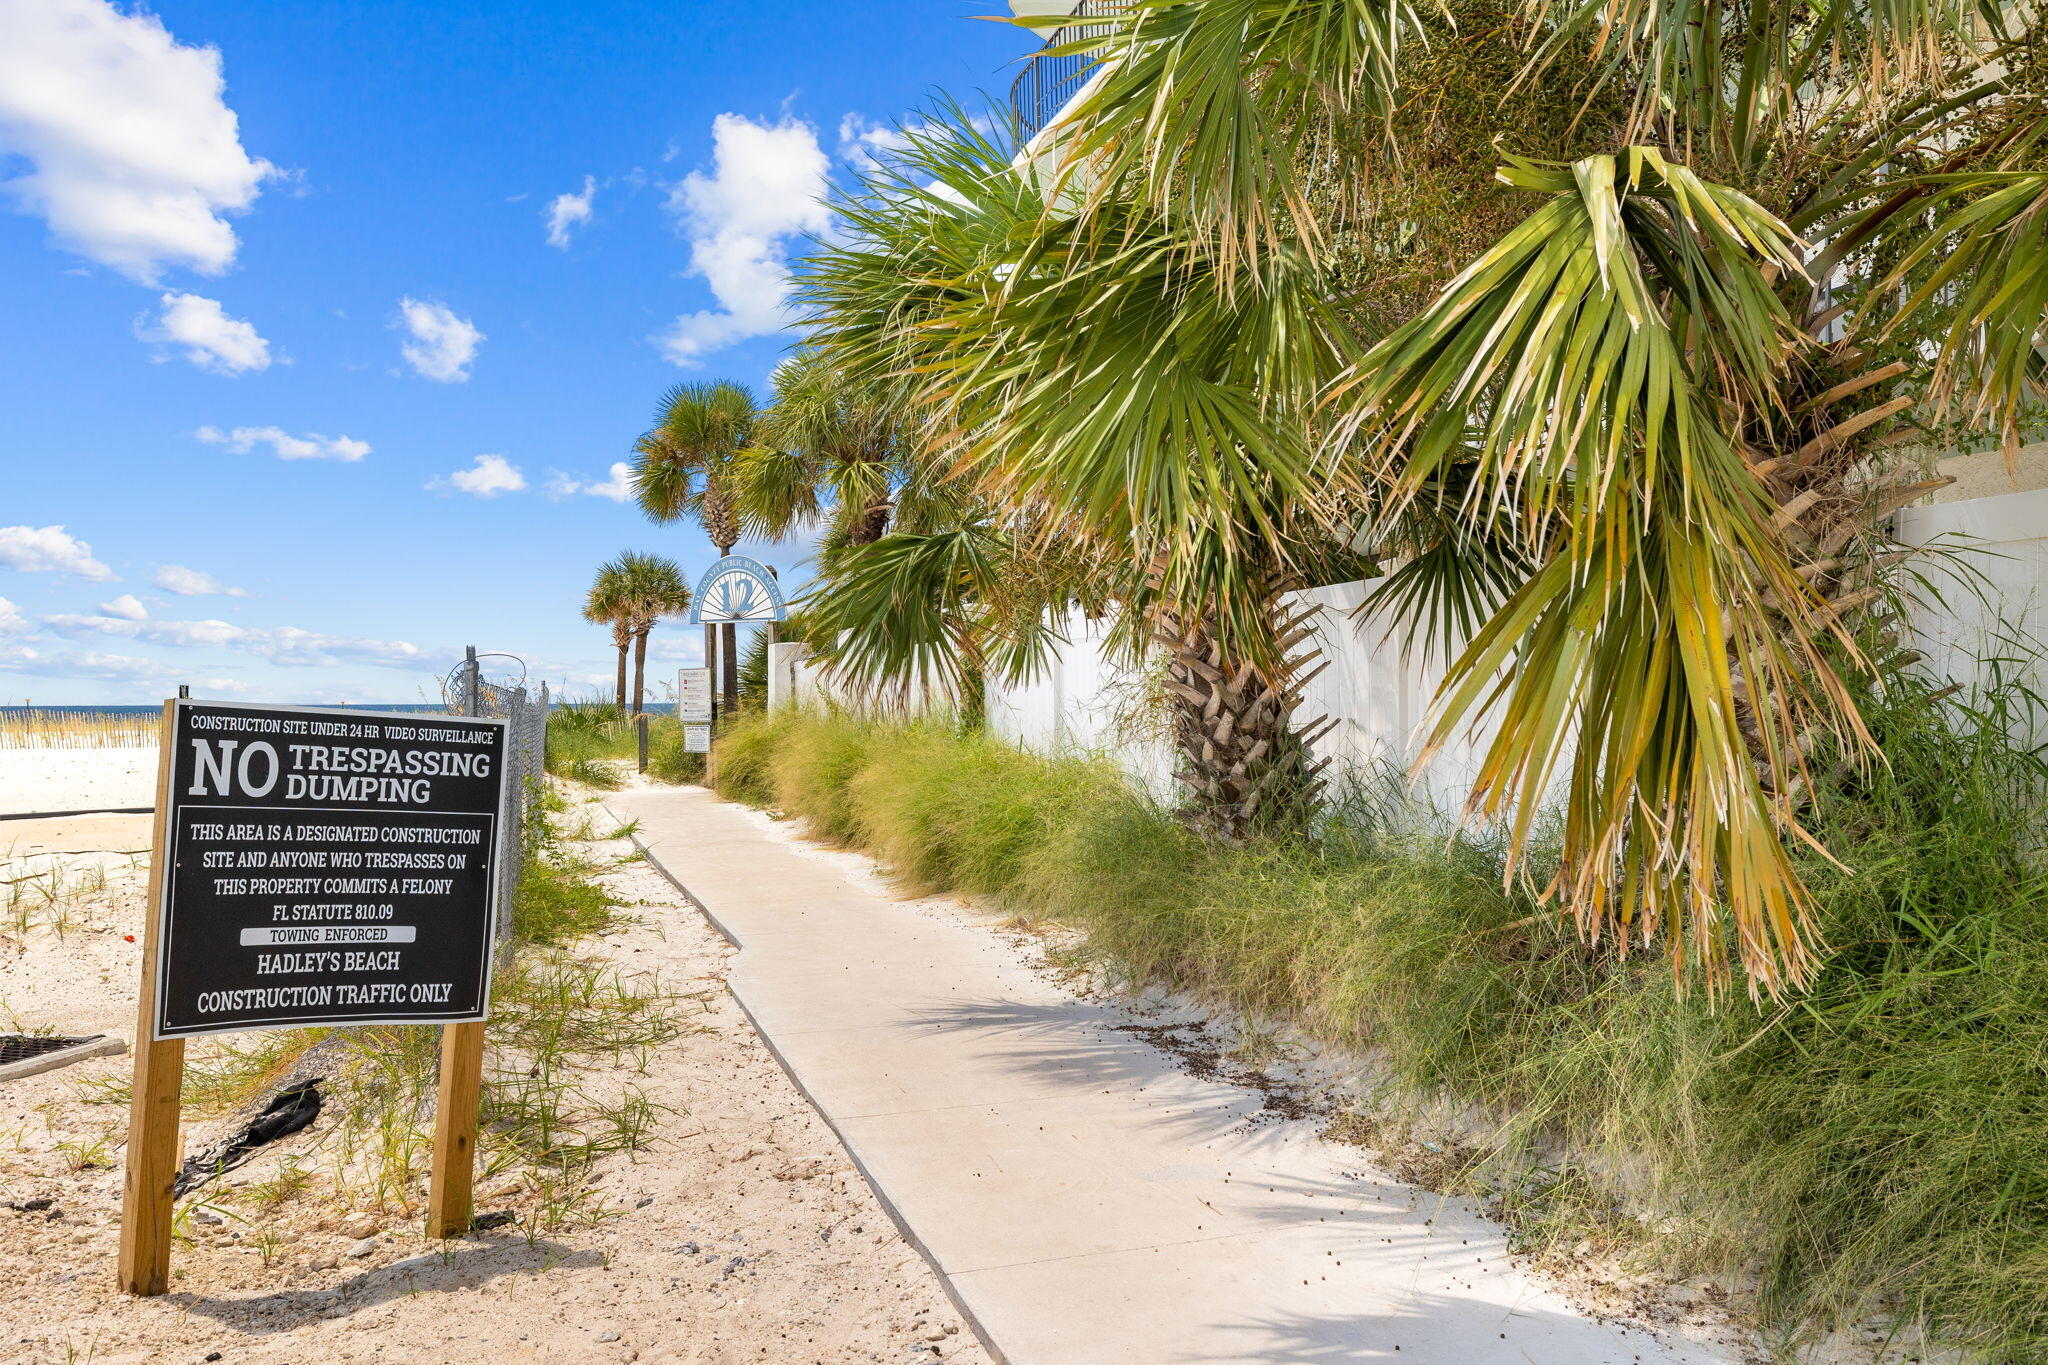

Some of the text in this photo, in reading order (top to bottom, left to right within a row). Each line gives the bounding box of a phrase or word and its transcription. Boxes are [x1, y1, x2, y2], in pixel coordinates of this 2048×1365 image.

[700, 565, 720, 591] COUNTY
[721, 559, 742, 568] PUBLIC
[744, 560, 765, 577] BEACH
[766, 577, 782, 606] ACCESS
[719, 579, 754, 612] 12
[191, 715, 494, 744] CONSTRUCTION SITE UNDER 24 HR VIDEO SURVEILLANCE
[189, 739, 490, 797] NO TRESPASSING
[286, 774, 430, 803] DUMPING
[191, 824, 480, 844] THIS AREA IS A DESIGNATED CONSTRUCTION
[203, 852, 466, 869] SITE AND ANYONE WHO TRESPASSES ON
[214, 879, 453, 895] THIS PROPERTY COMMITS A FELONY
[273, 904, 393, 920] FL STATUTE 810.09
[269, 927, 389, 944] TOWING ENFORCED
[257, 952, 400, 974] HADLEY'S BEACH
[198, 984, 452, 1013] CONSTRUCTION TRAFFIC ONLY
